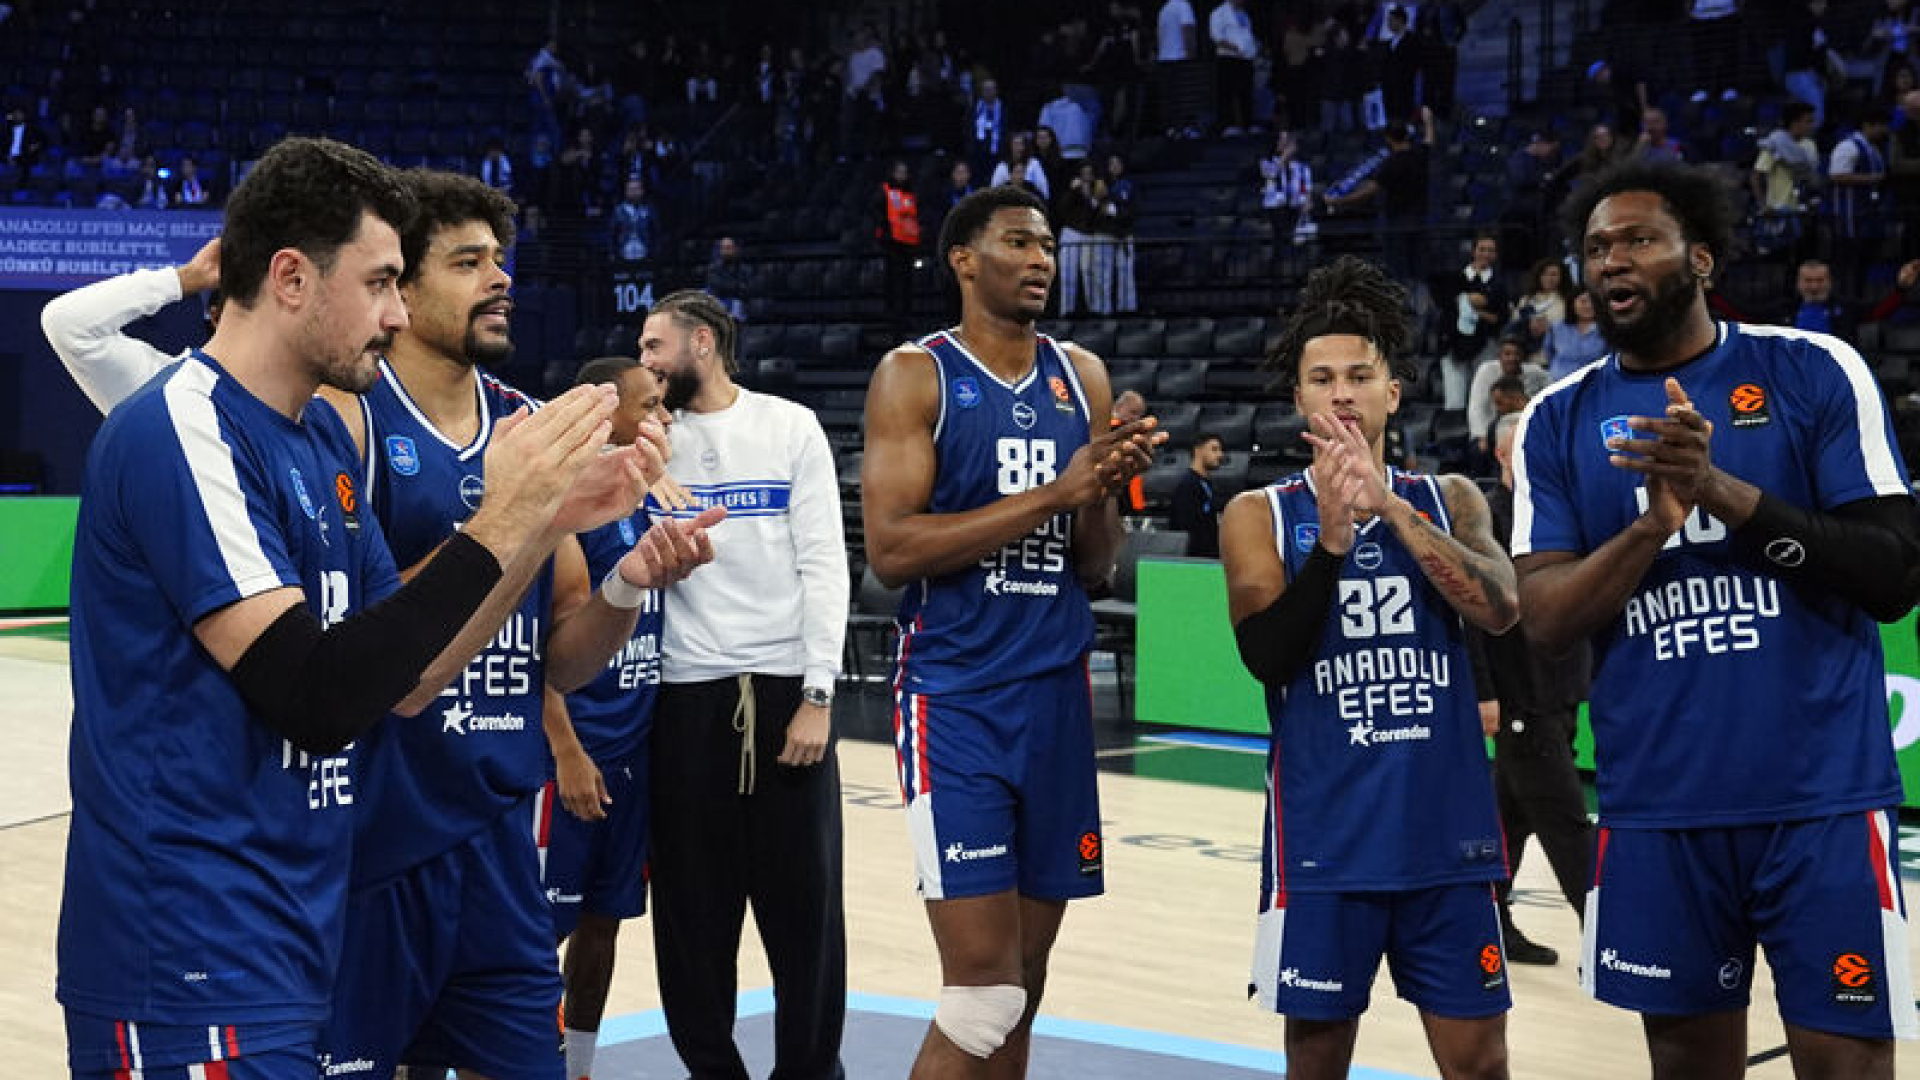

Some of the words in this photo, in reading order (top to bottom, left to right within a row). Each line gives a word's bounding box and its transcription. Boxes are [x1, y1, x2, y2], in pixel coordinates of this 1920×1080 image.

[614, 283, 653, 312] 104
[997, 437, 1056, 494] 88
[1338, 575, 1416, 638] 32
[1626, 575, 1781, 637] ANADOLU
[1654, 613, 1760, 661] EFES
[1314, 647, 1450, 695] ANADOLU
[1338, 683, 1434, 719] EFES
[1372, 724, 1431, 742] corendon
[1615, 958, 1672, 979] corendon
